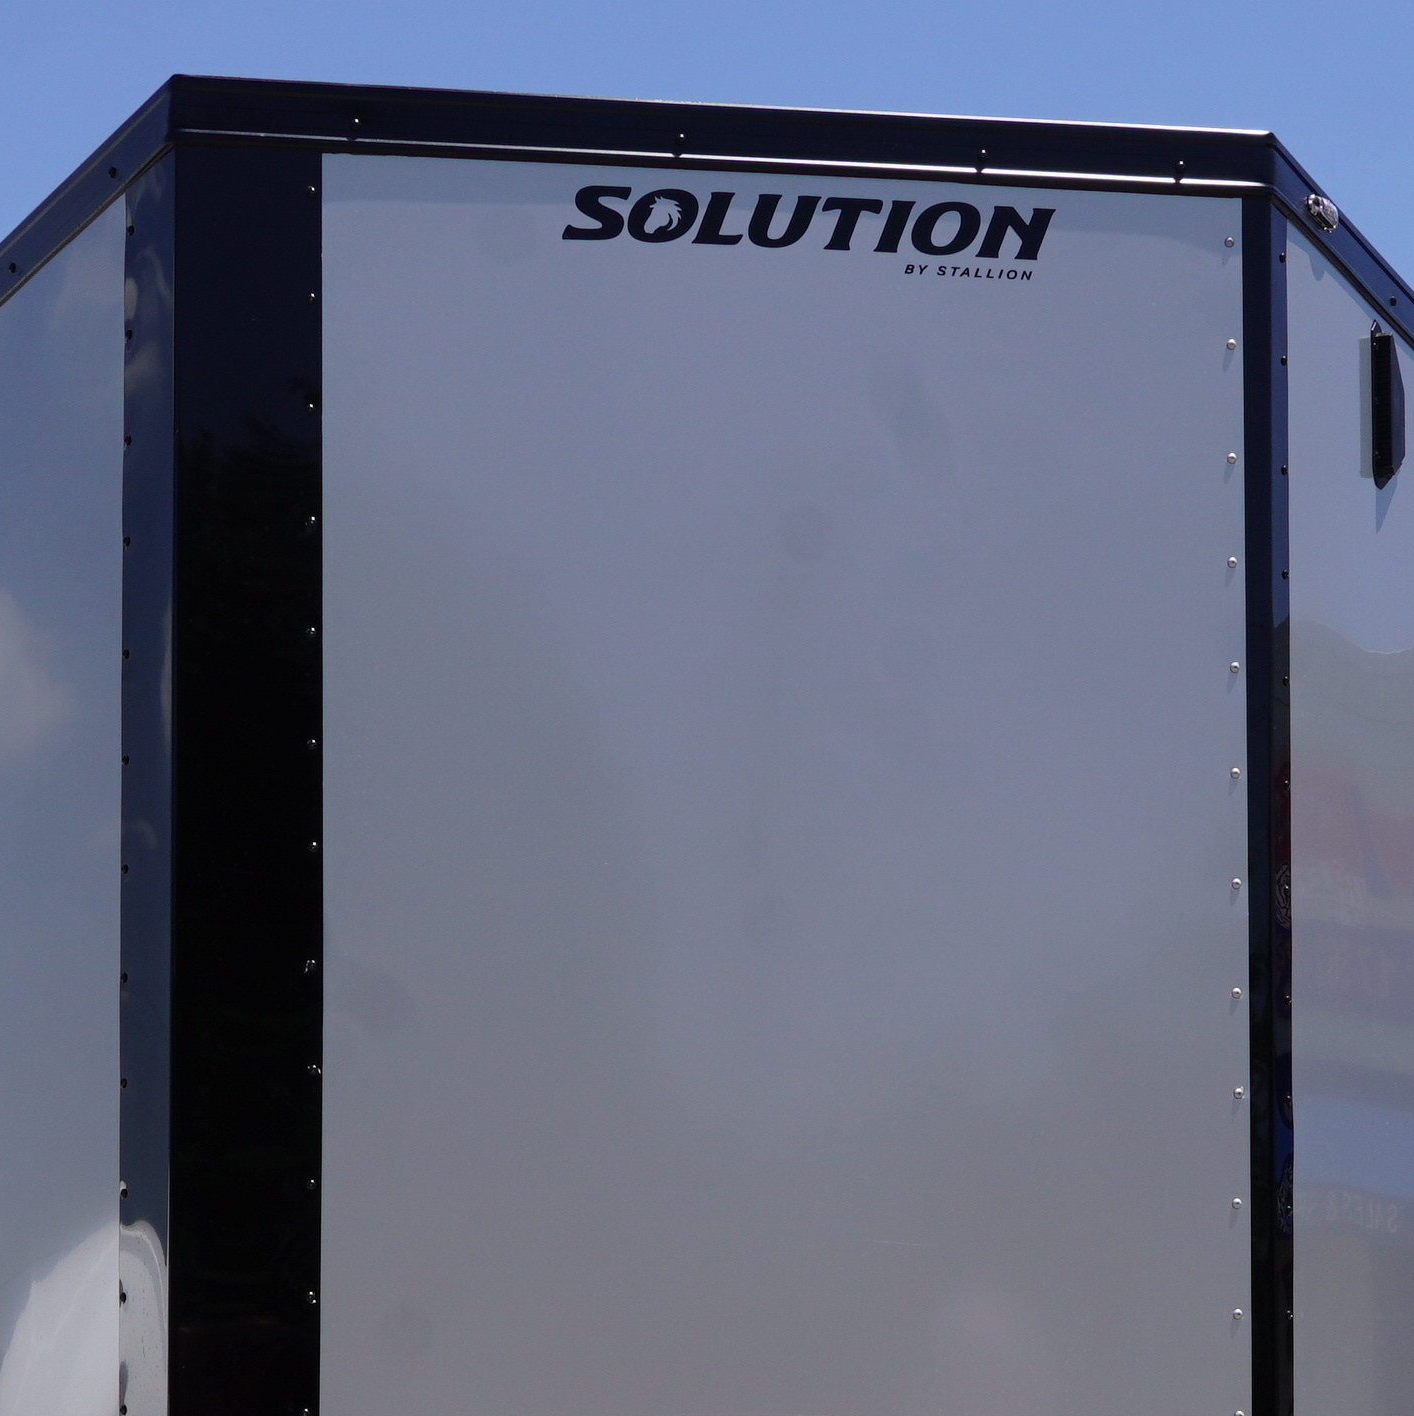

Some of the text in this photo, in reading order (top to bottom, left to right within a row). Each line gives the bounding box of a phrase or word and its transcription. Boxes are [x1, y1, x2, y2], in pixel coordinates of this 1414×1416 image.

[562, 185, 1057, 261] SOLUTION
[904, 264, 1033, 281] BY STALLION
